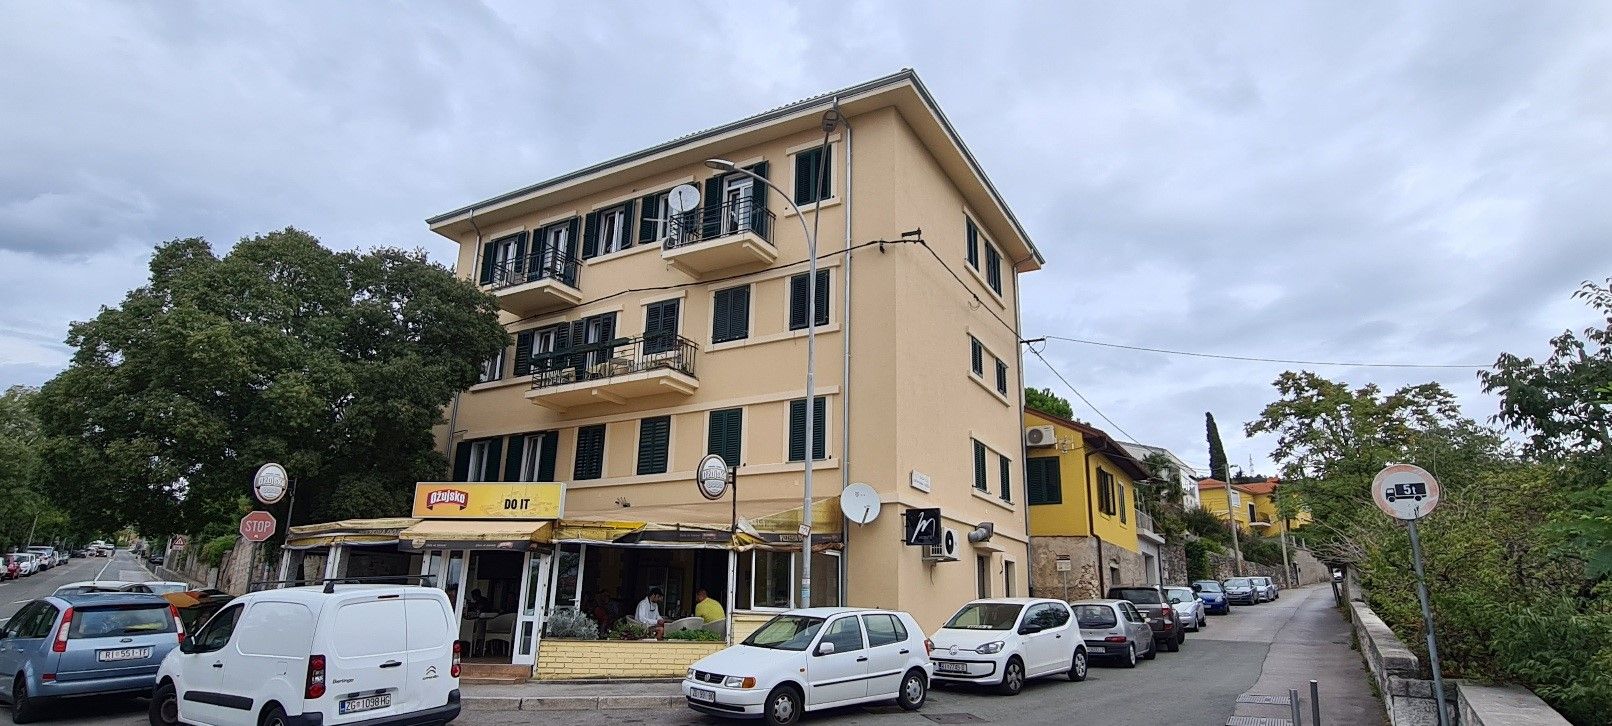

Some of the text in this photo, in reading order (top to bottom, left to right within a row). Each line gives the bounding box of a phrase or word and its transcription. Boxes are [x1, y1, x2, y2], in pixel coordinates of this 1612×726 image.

[430, 489, 466, 504] Ožujsko
[504, 498, 531, 510] DO IT
[245, 520, 271, 533] STOP
[345, 702, 357, 711] ZG
